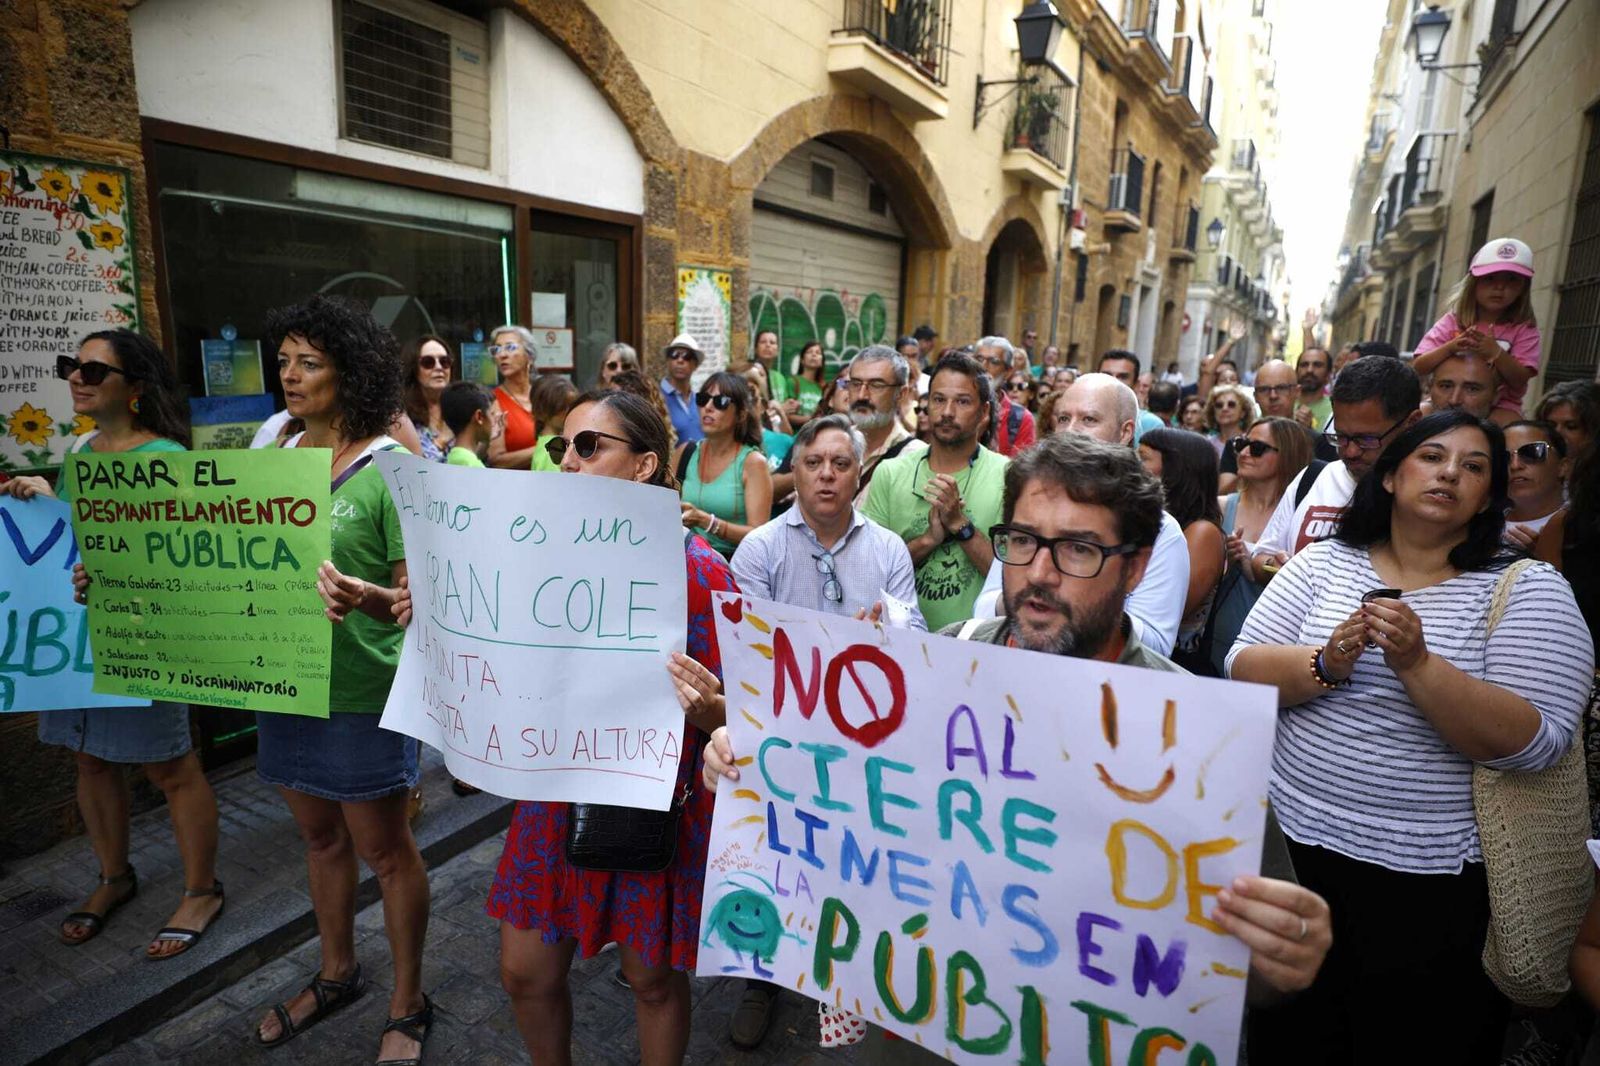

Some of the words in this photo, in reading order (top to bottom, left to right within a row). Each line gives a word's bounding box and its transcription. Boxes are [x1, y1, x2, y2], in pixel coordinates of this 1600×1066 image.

[21, 228, 61, 246] BREAD
[75, 459, 179, 495] PARAR
[193, 458, 237, 488] EL
[76, 495, 317, 527] DESMANTELAMIENTO
[510, 515, 548, 545] es
[574, 517, 648, 546] un
[144, 526, 301, 572] PÚBLICA
[166, 577, 181, 593] 23
[245, 579, 255, 592] 1
[103, 598, 130, 614] Carlos
[246, 602, 257, 617] 1
[532, 576, 660, 641] COLE
[103, 664, 161, 681] INJUSTO
[773, 626, 907, 749] NO
[945, 703, 1037, 781] AL
[485, 723, 503, 761] A
[521, 727, 558, 758] SU
[572, 727, 680, 769] ALTURA
[758, 736, 1059, 873] CIERE
[1106, 817, 1244, 935] DE
[766, 801, 1060, 968] LINEAS
[1076, 911, 1187, 998] EN
[776, 859, 815, 904] LA
